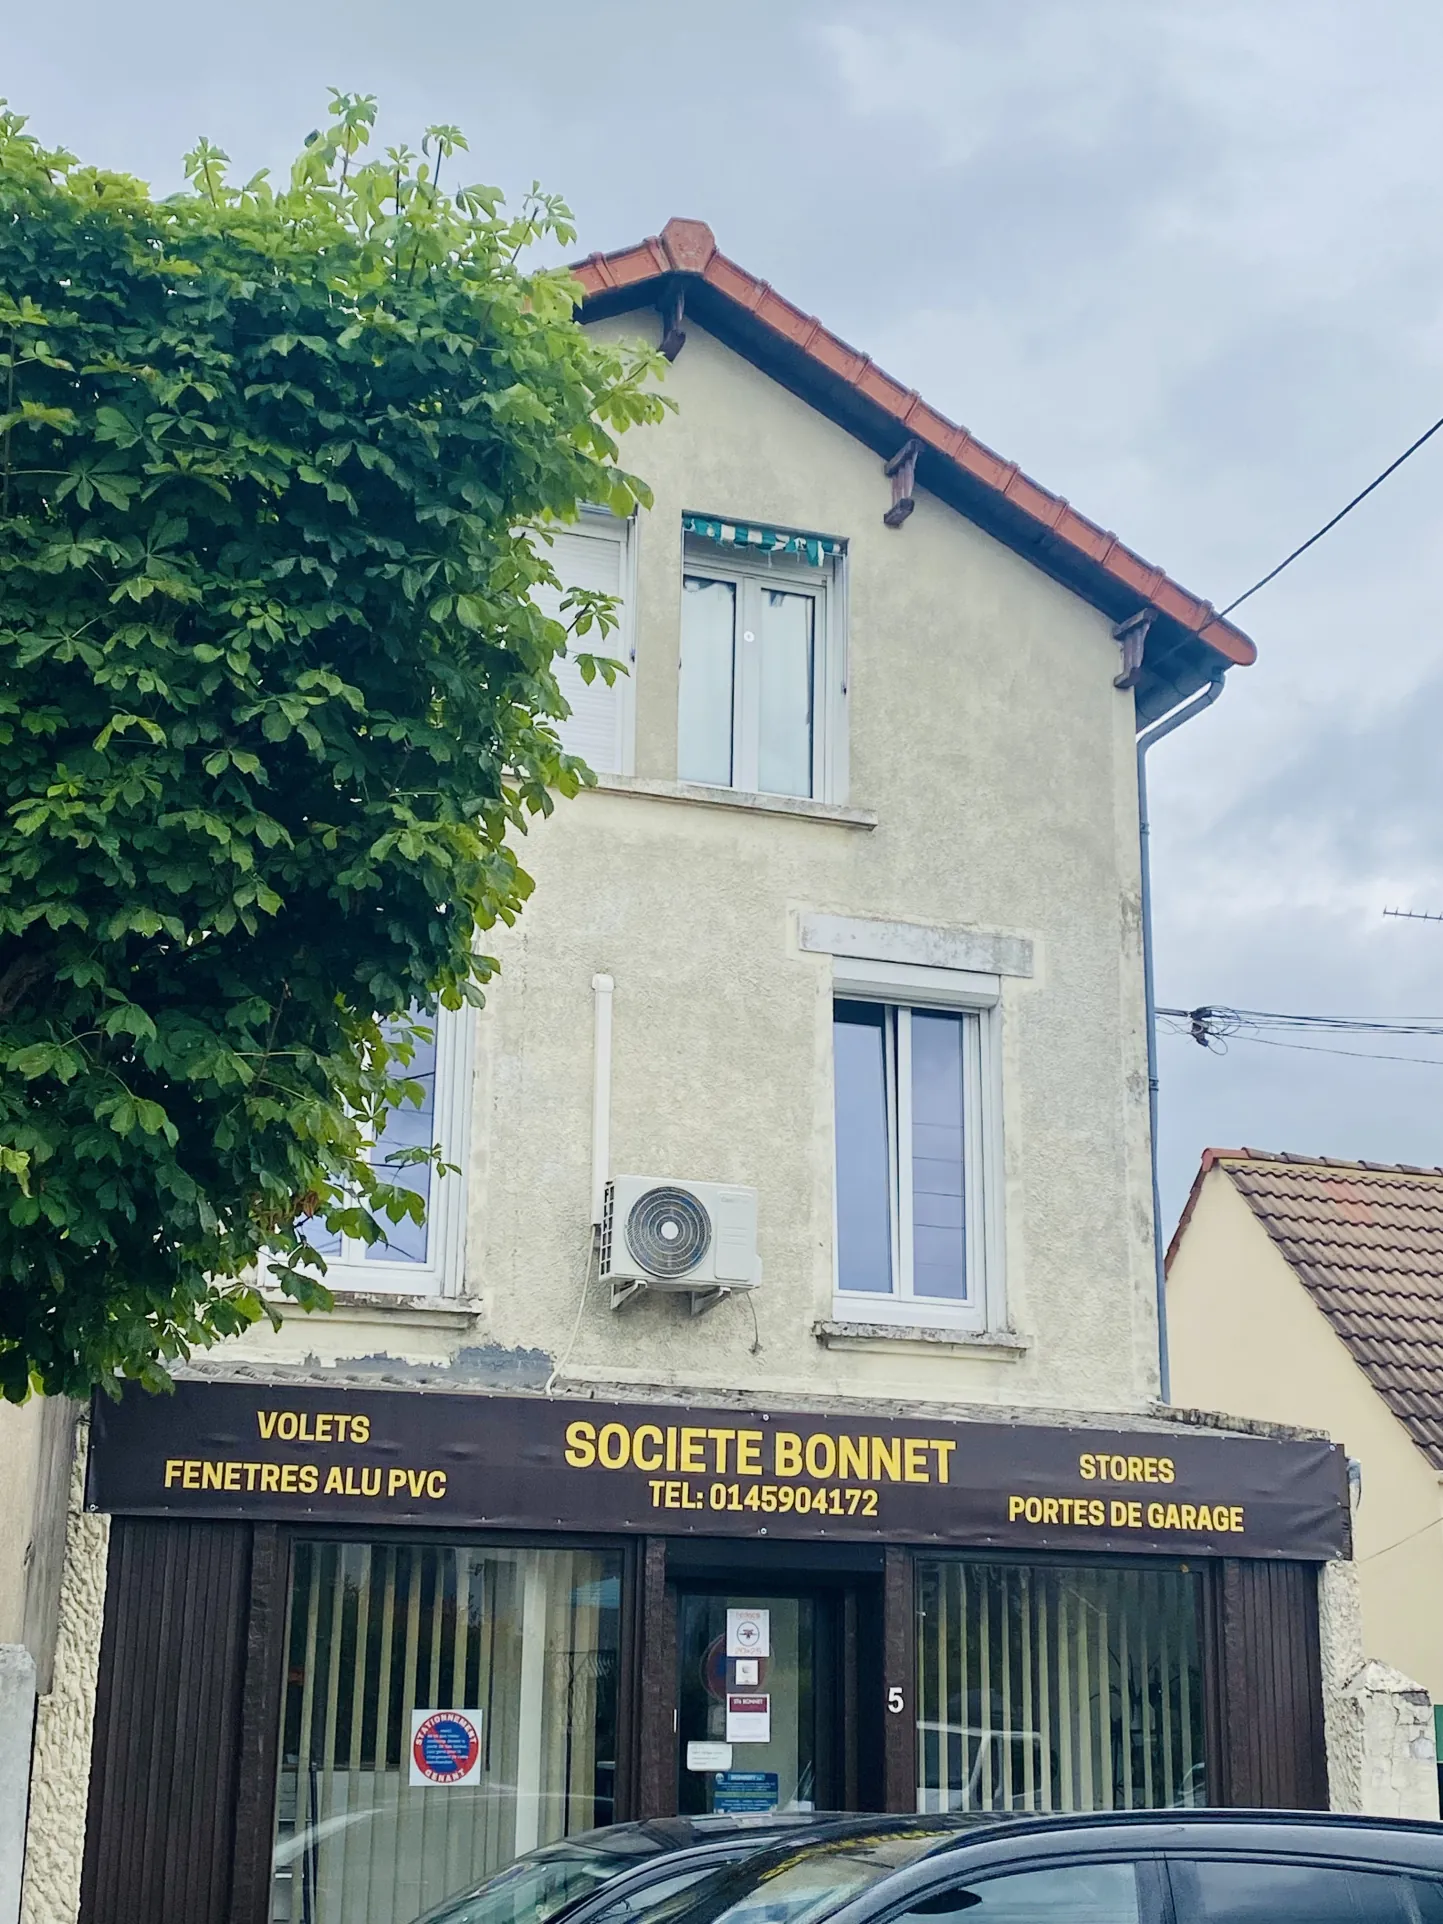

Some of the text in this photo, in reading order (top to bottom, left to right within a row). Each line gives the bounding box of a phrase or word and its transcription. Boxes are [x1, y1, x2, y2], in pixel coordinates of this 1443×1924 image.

[257, 1411, 371, 1443] VOLETS
[564, 1421, 957, 1484] SOCIETE BONNET
[1079, 1453, 1176, 1484] STORES
[164, 1459, 447, 1499] FENETRES ALU PVC
[648, 1480, 879, 1517] TEL: 0145904172
[1008, 1495, 1245, 1533] PORTES DE GARAGE
[887, 1686, 904, 1714] 5
[415, 1713, 477, 1746] STATIONNEMENT
[424, 1768, 465, 1783] GENANT
